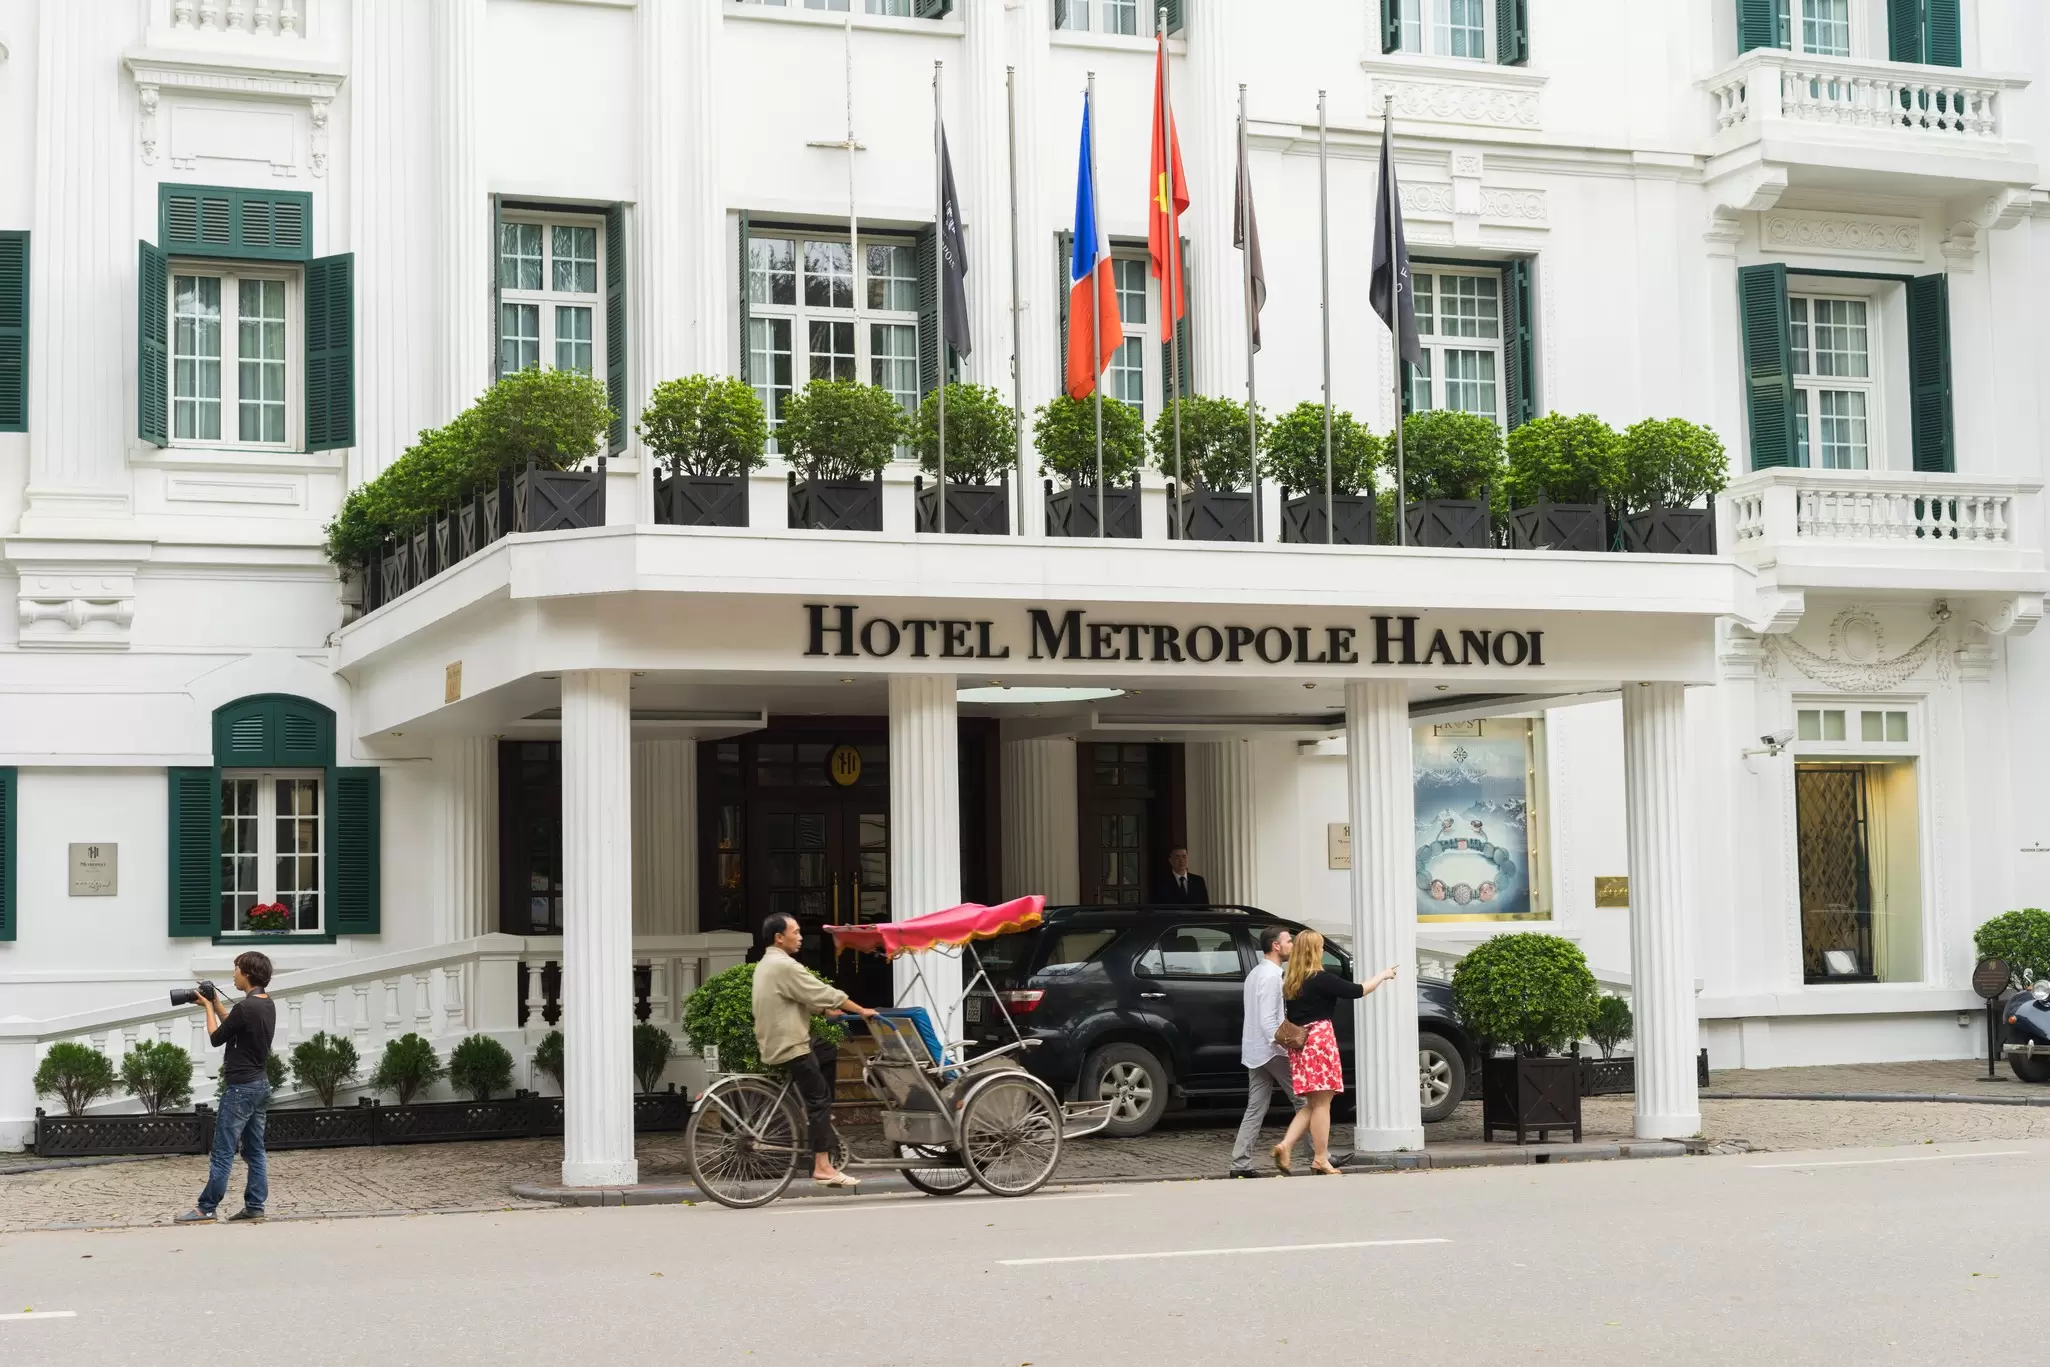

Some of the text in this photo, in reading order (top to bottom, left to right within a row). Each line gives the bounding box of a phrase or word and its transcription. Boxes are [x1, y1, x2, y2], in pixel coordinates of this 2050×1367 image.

[803, 603, 1546, 667] HOTEL METROPOLE HANOI
